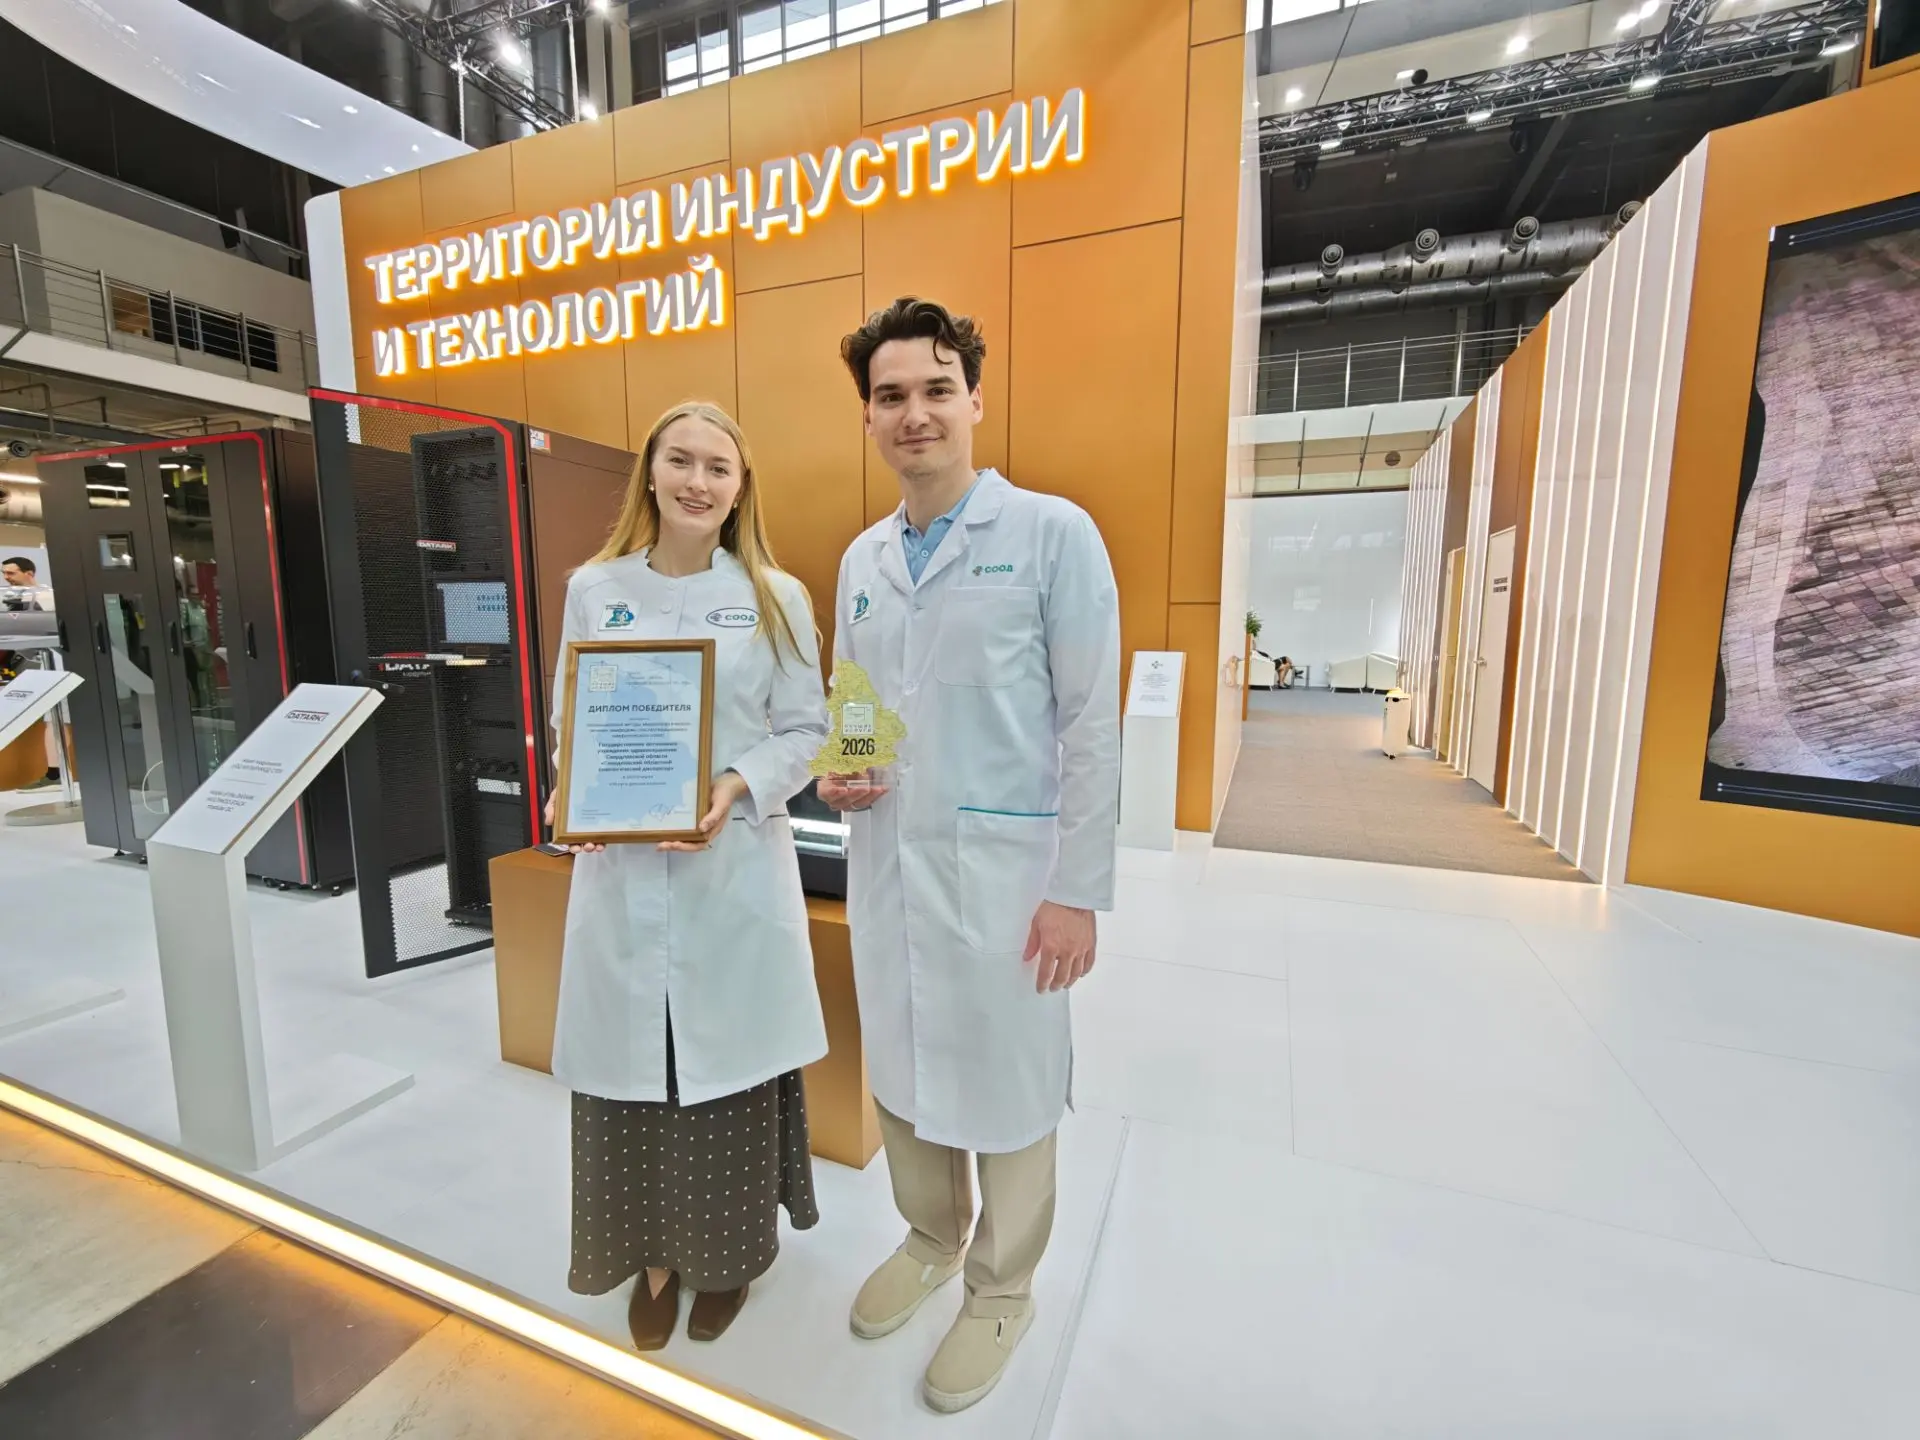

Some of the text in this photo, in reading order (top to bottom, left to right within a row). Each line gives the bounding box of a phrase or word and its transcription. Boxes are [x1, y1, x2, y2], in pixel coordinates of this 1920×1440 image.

[364, 87, 1086, 304] ТЕРРИТОРИЯ ИНДУСТРИИ
[371, 252, 725, 377] И ТЕХНОЛОГИЙ
[286, 712, 323, 722] DATARK
[588, 704, 692, 713] ДИПЛОМ ПОБЕДИТЕЛЯ
[841, 738, 875, 756] 2026
